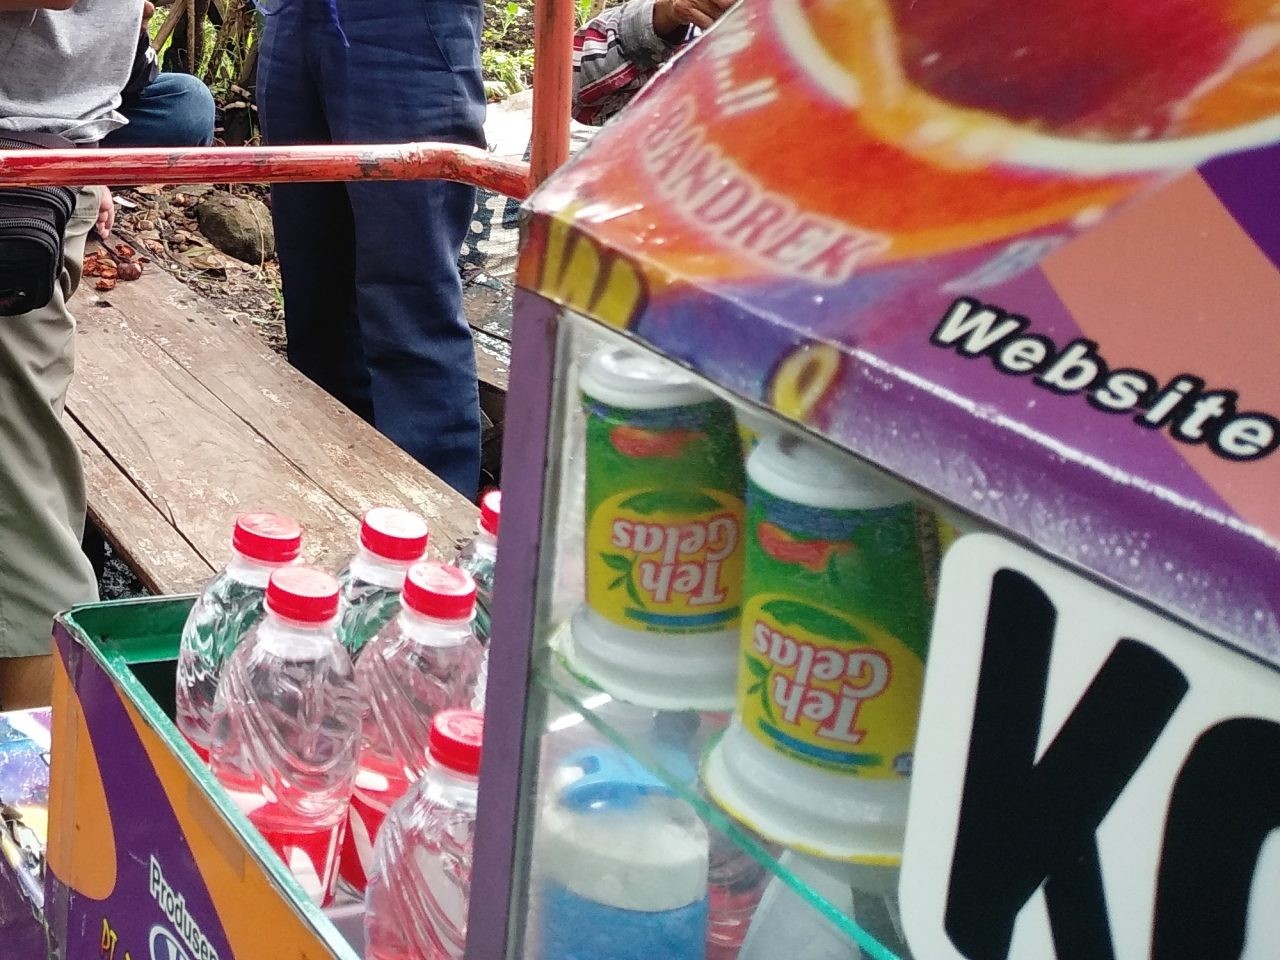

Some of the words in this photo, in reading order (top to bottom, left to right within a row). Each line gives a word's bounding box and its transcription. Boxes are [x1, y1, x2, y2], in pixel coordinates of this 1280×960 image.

[932, 297, 1280, 461] Website
[612, 511, 741, 565] Gelas
[640, 552, 729, 606] Teh
[753, 621, 892, 699] Gelas
[772, 673, 868, 745] Teh
